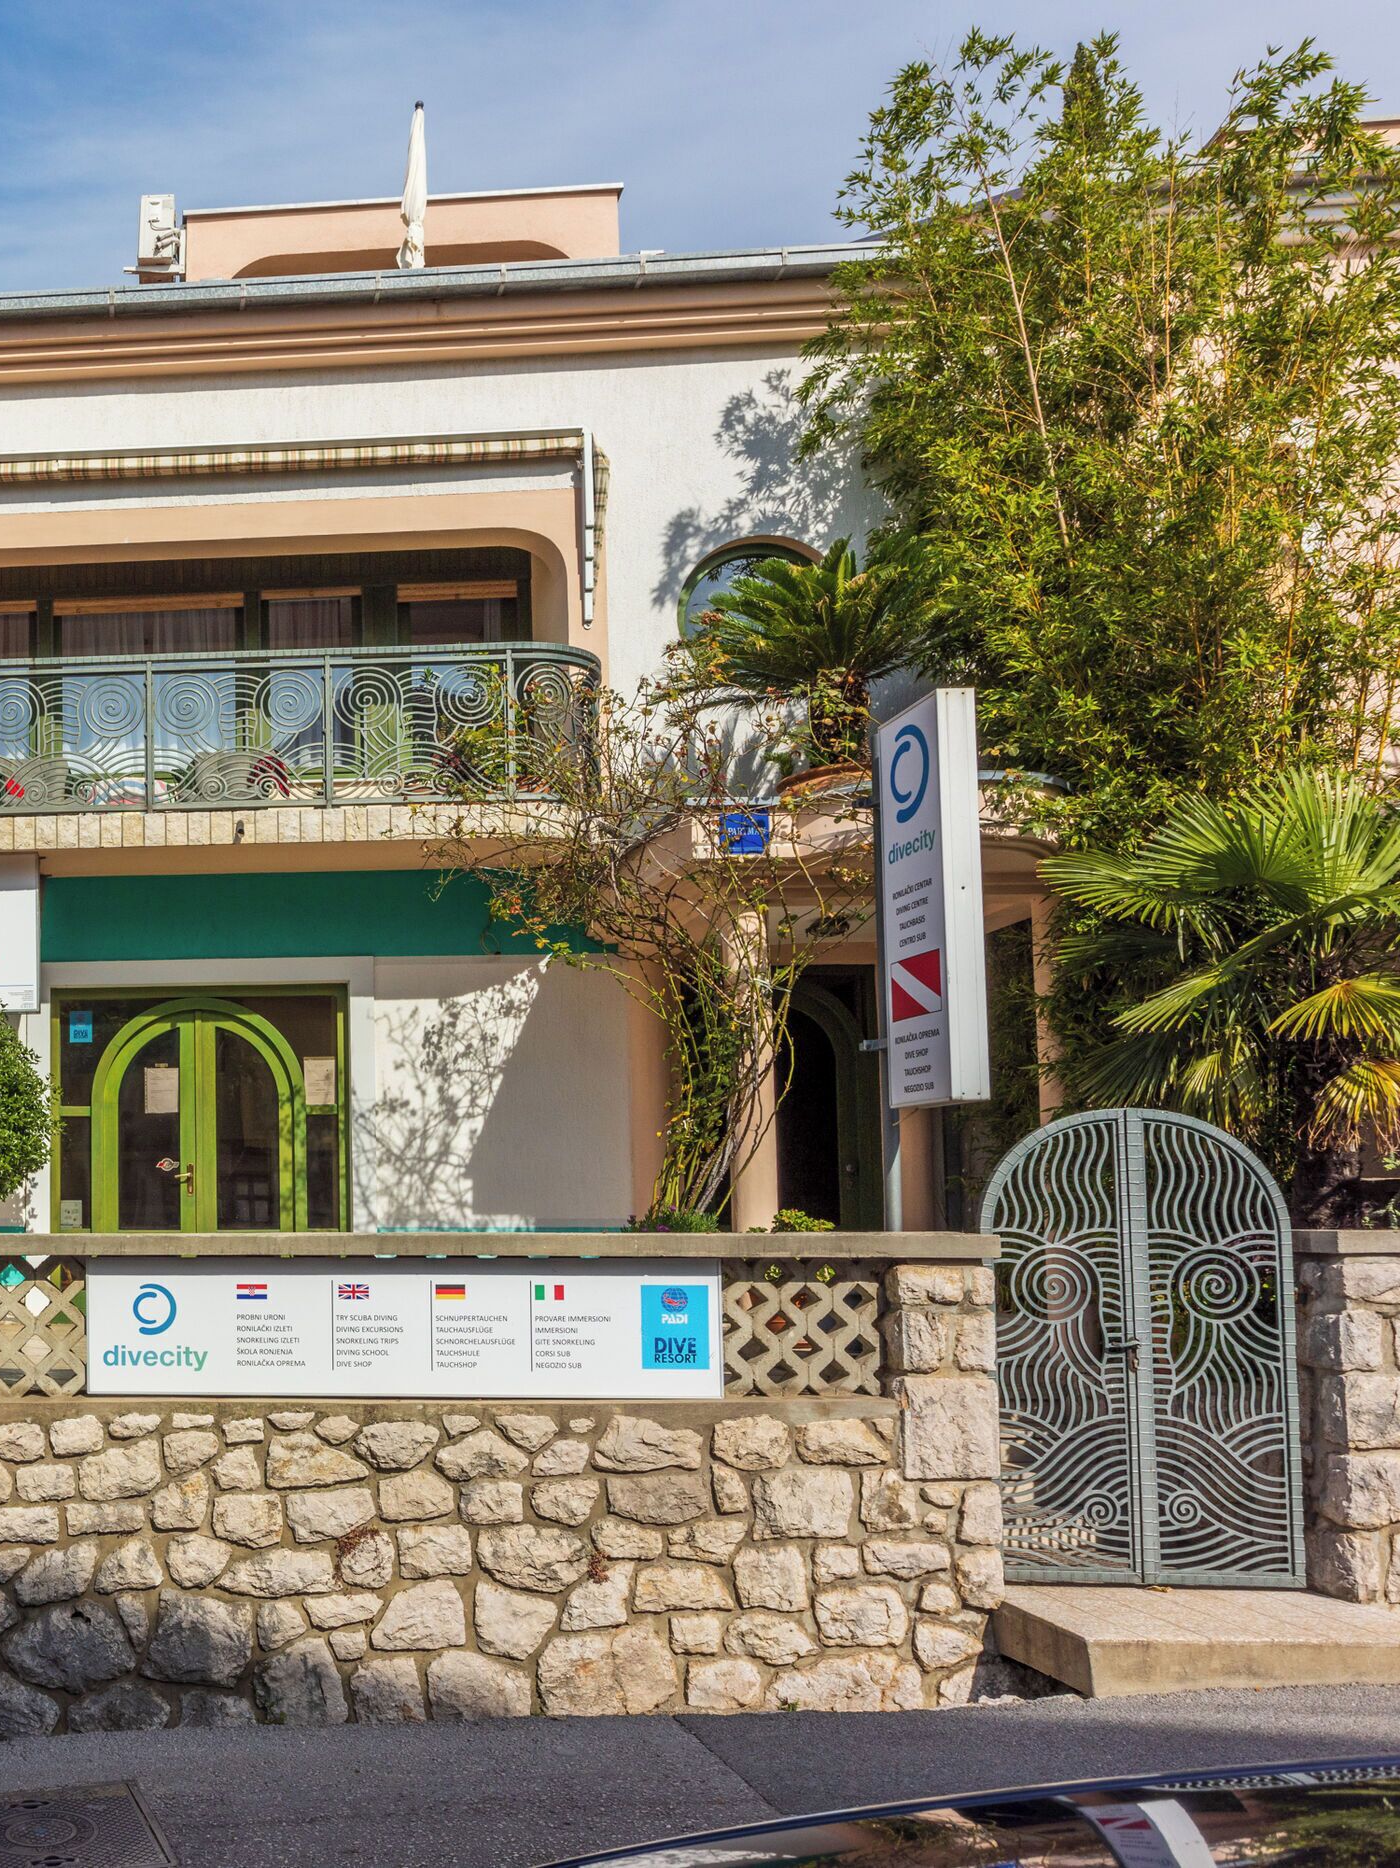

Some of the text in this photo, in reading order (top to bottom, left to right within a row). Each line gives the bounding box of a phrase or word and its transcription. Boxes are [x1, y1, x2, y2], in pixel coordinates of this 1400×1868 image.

[888, 828, 936, 865] divecity
[915, 877, 933, 892] CENTAR
[896, 896, 929, 916] DIVING CENTRE
[899, 914, 926, 931] TAUCHBASIS
[899, 931, 927, 948] CENTRO SUB
[918, 1028, 941, 1040] OPREMA
[904, 1047, 929, 1060] DIVE SHOP
[904, 1064, 931, 1076] TAUCHSHOP
[903, 1081, 935, 1093] NEGOZIO SUB
[435, 1314, 508, 1322] SCHNUPPERTAUCHEN
[661, 1314, 688, 1324] PADI
[236, 1324, 272, 1332] RONILAČKI
[551, 1338, 595, 1346] SNORKELING
[654, 1337, 697, 1354] DIVE
[236, 1347, 258, 1355] ŠKOLA
[102, 1344, 208, 1372] divecity
[236, 1359, 275, 1367] RONILAČKA
[336, 1360, 373, 1368] DIVE SHOP
[654, 1354, 697, 1363] RESORT
